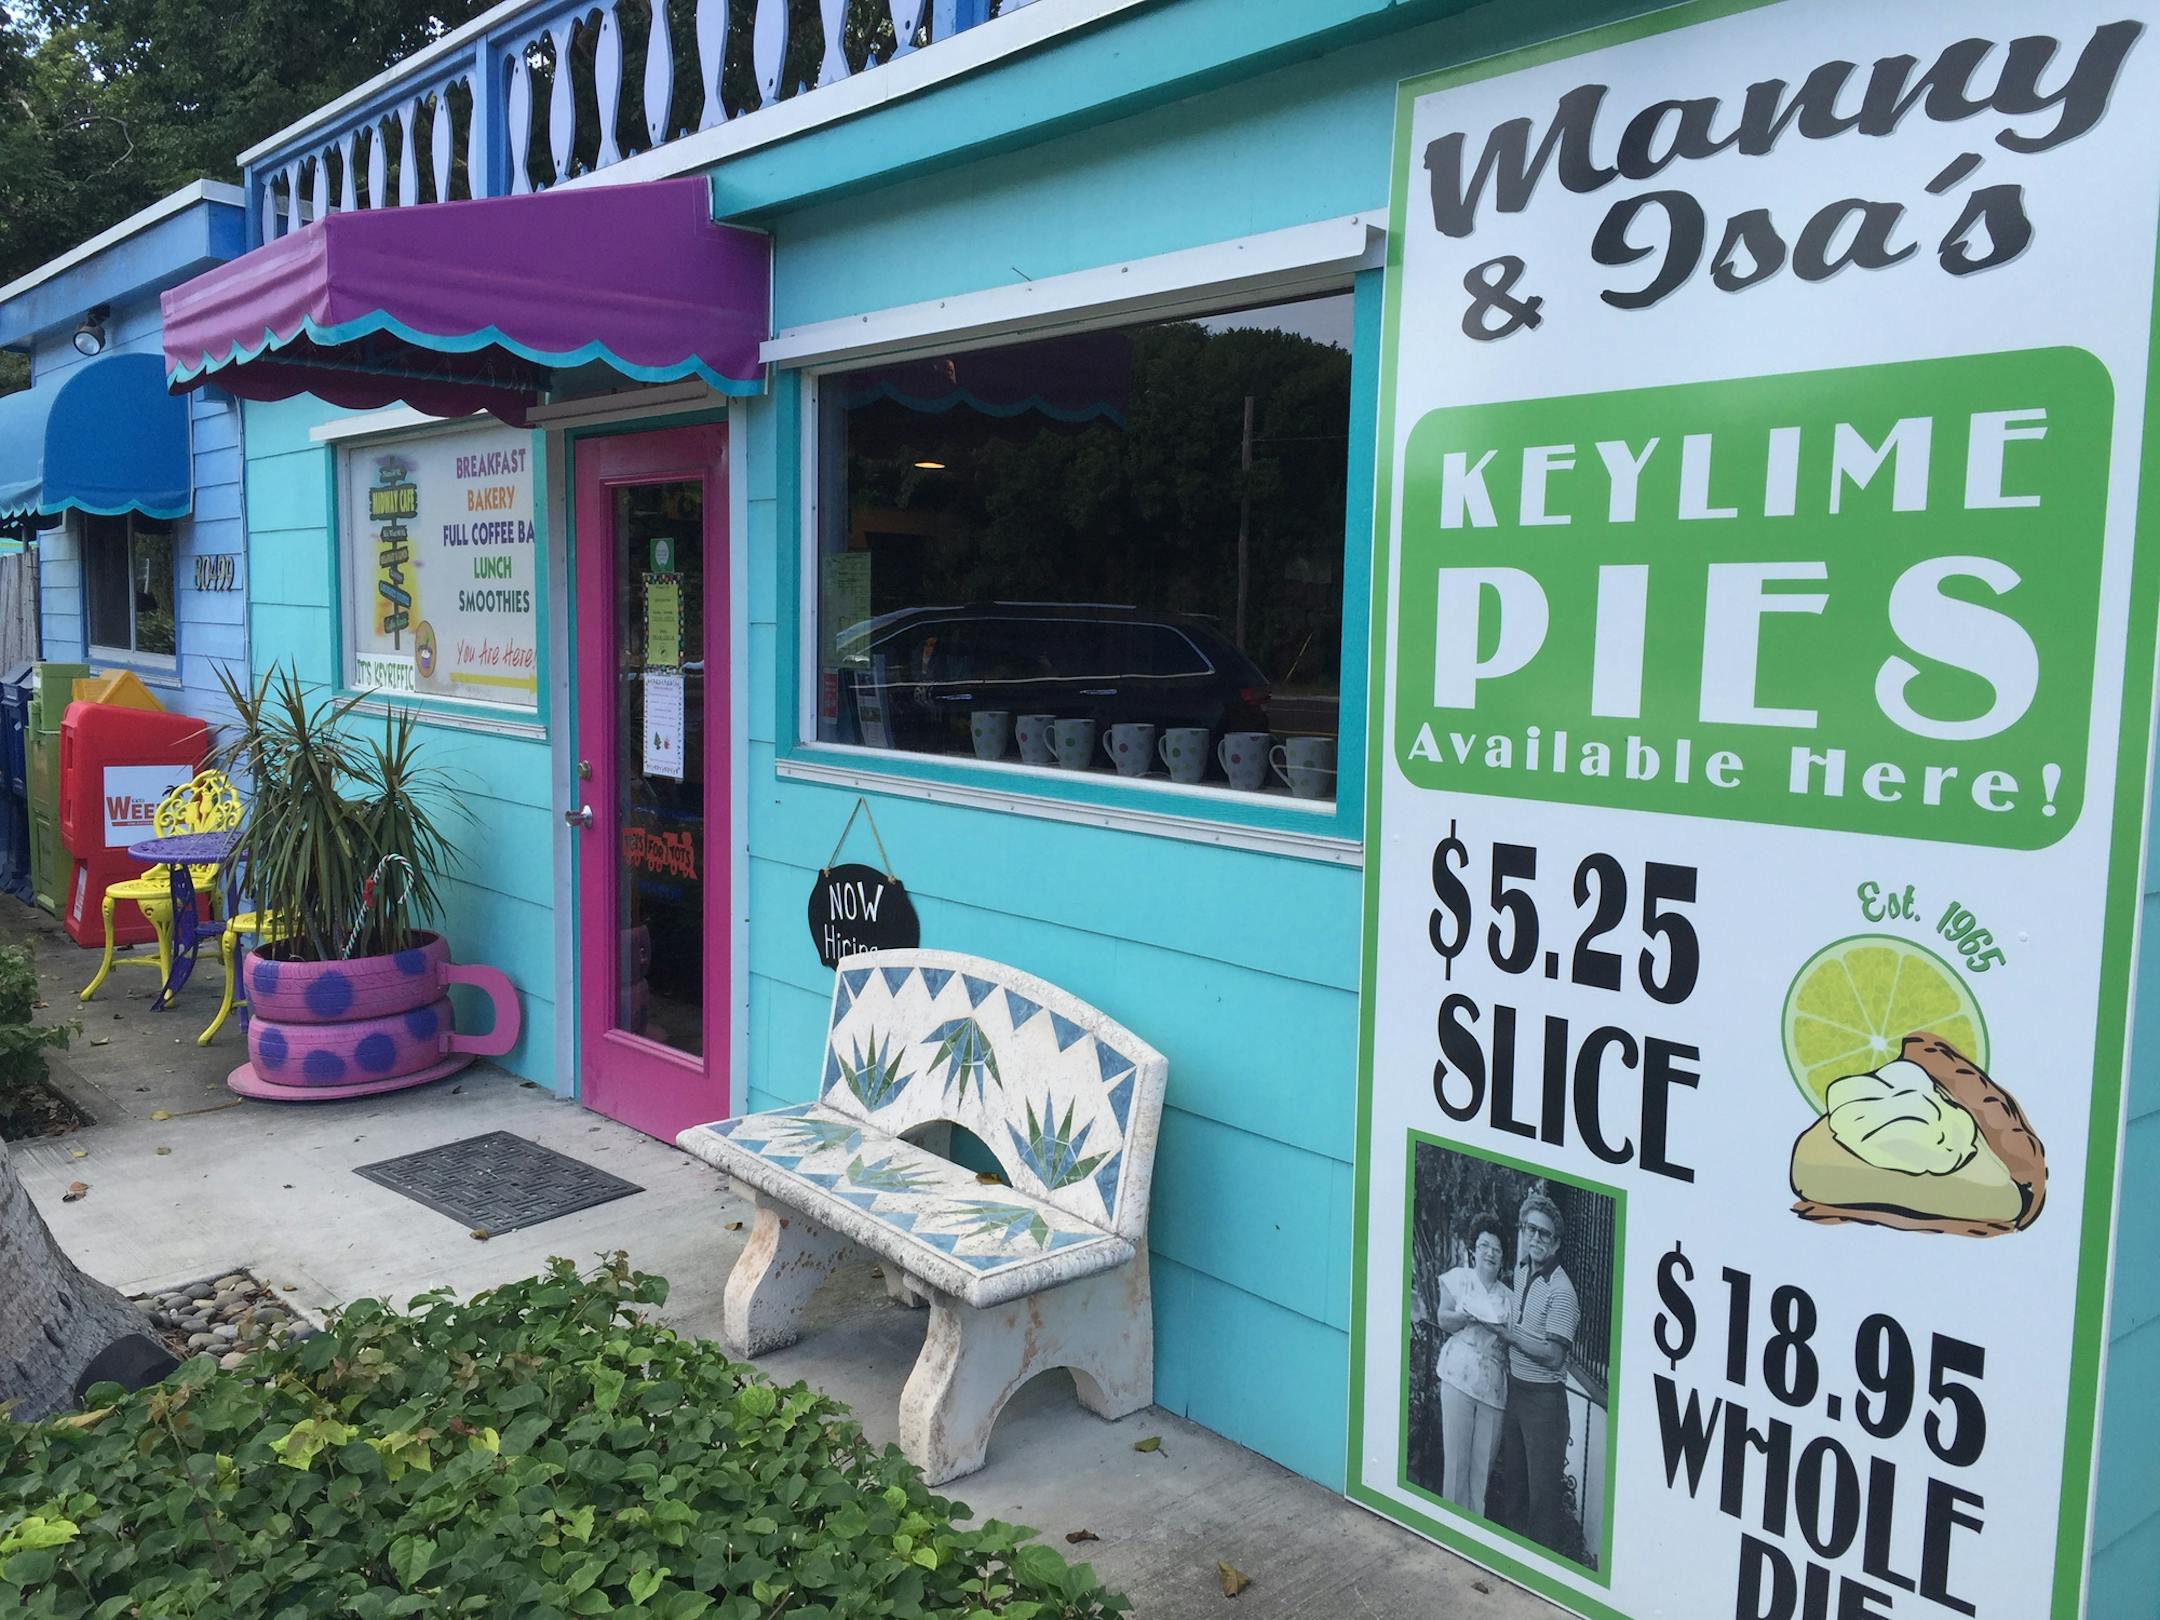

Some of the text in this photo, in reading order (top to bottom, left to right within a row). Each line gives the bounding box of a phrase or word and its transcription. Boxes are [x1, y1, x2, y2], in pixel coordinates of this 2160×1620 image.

[1424, 20, 2145, 238] Manny
[1461, 152, 2036, 341] & Isa's
[456, 448, 526, 479] BREAKFAST
[467, 485, 515, 512] BAKERY
[1440, 407, 2049, 529] KEYLIME
[443, 524, 469, 547] FULL
[472, 521, 515, 546] COFFEE
[473, 556, 512, 579] LUNCH
[459, 590, 530, 613] SMOOTHIES
[1433, 555, 2040, 741] PIES
[457, 639, 476, 665] You
[479, 637, 500, 666] Are
[106, 796, 161, 820] WEE
[1408, 722, 2062, 818] Available Here!
[824, 923, 878, 960] Hiri
[829, 881, 884, 922] NOW
[1428, 818, 1700, 1005] $5.25
[1857, 880, 2006, 973] Est. 1965
[1433, 992, 1701, 1184] SLICE
[1653, 1240, 1987, 1468] $18.95
[1653, 1373, 1986, 1618] WHOLE
